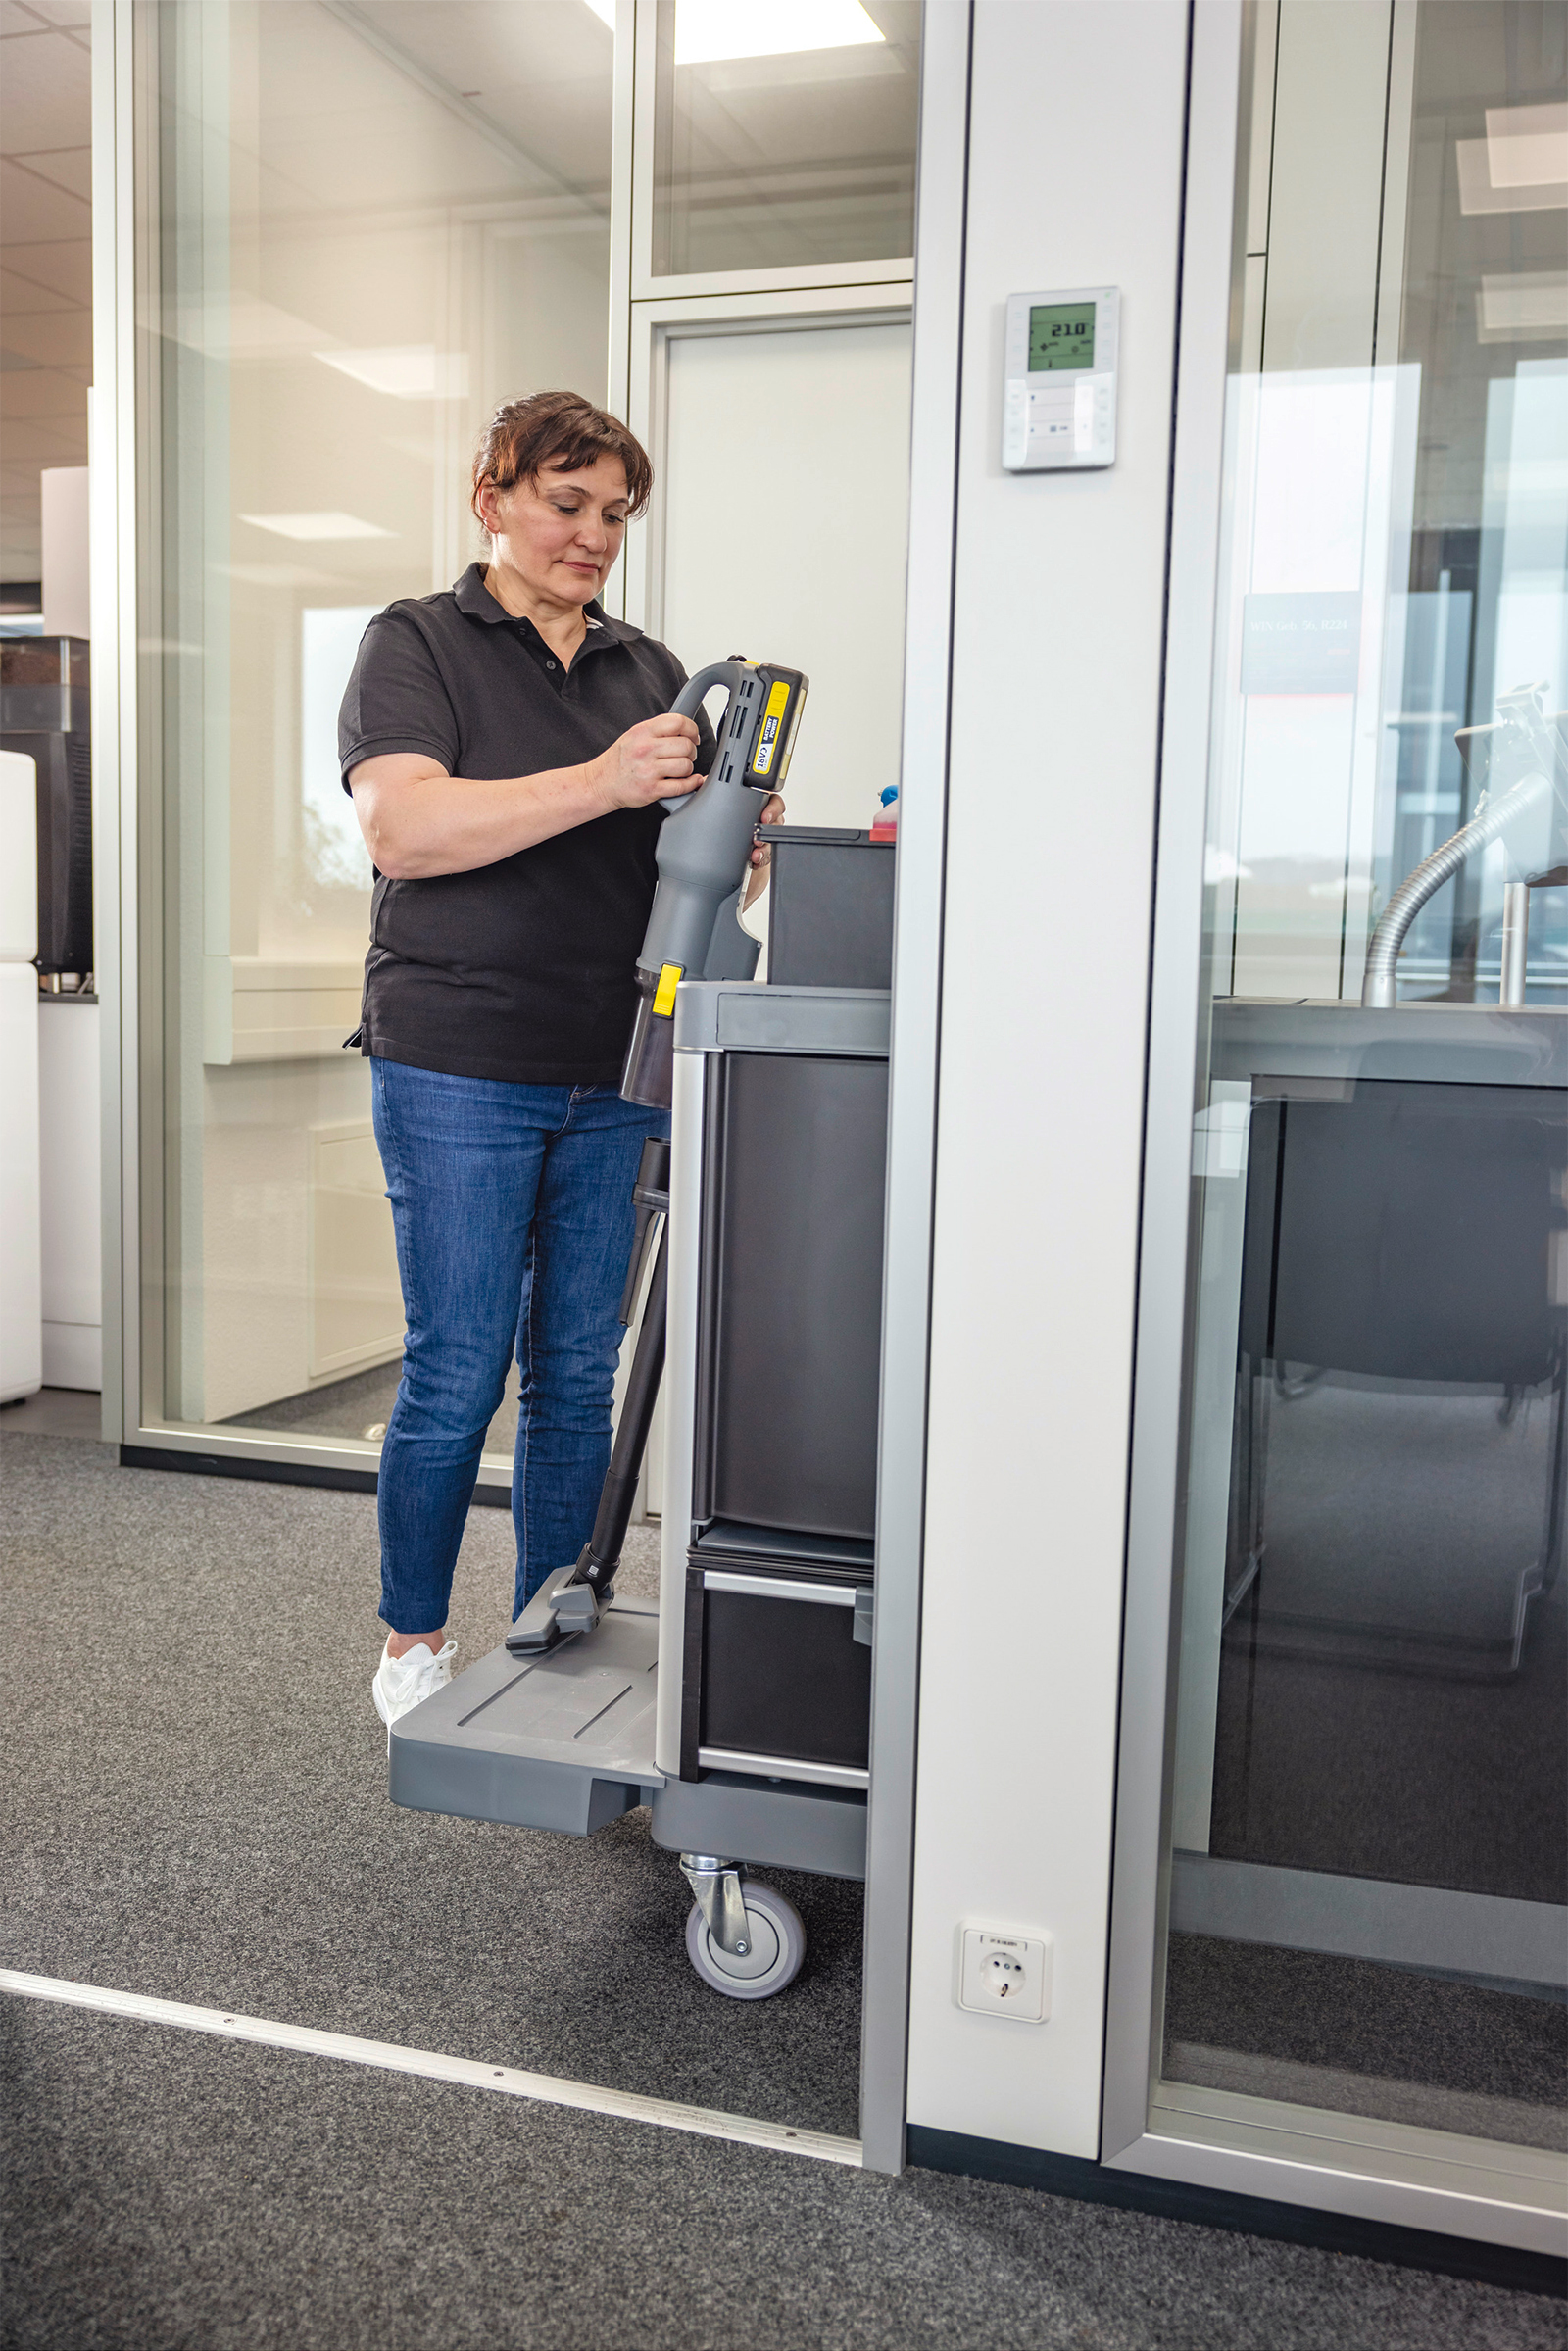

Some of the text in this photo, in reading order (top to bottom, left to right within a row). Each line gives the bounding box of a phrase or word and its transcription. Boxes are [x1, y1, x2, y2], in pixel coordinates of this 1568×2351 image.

[1250, 620, 1273, 632] WIN
[1321, 619, 1348, 630] R224
[763, 717, 772, 741] BATTERY
[769, 718, 778, 738] POWER
